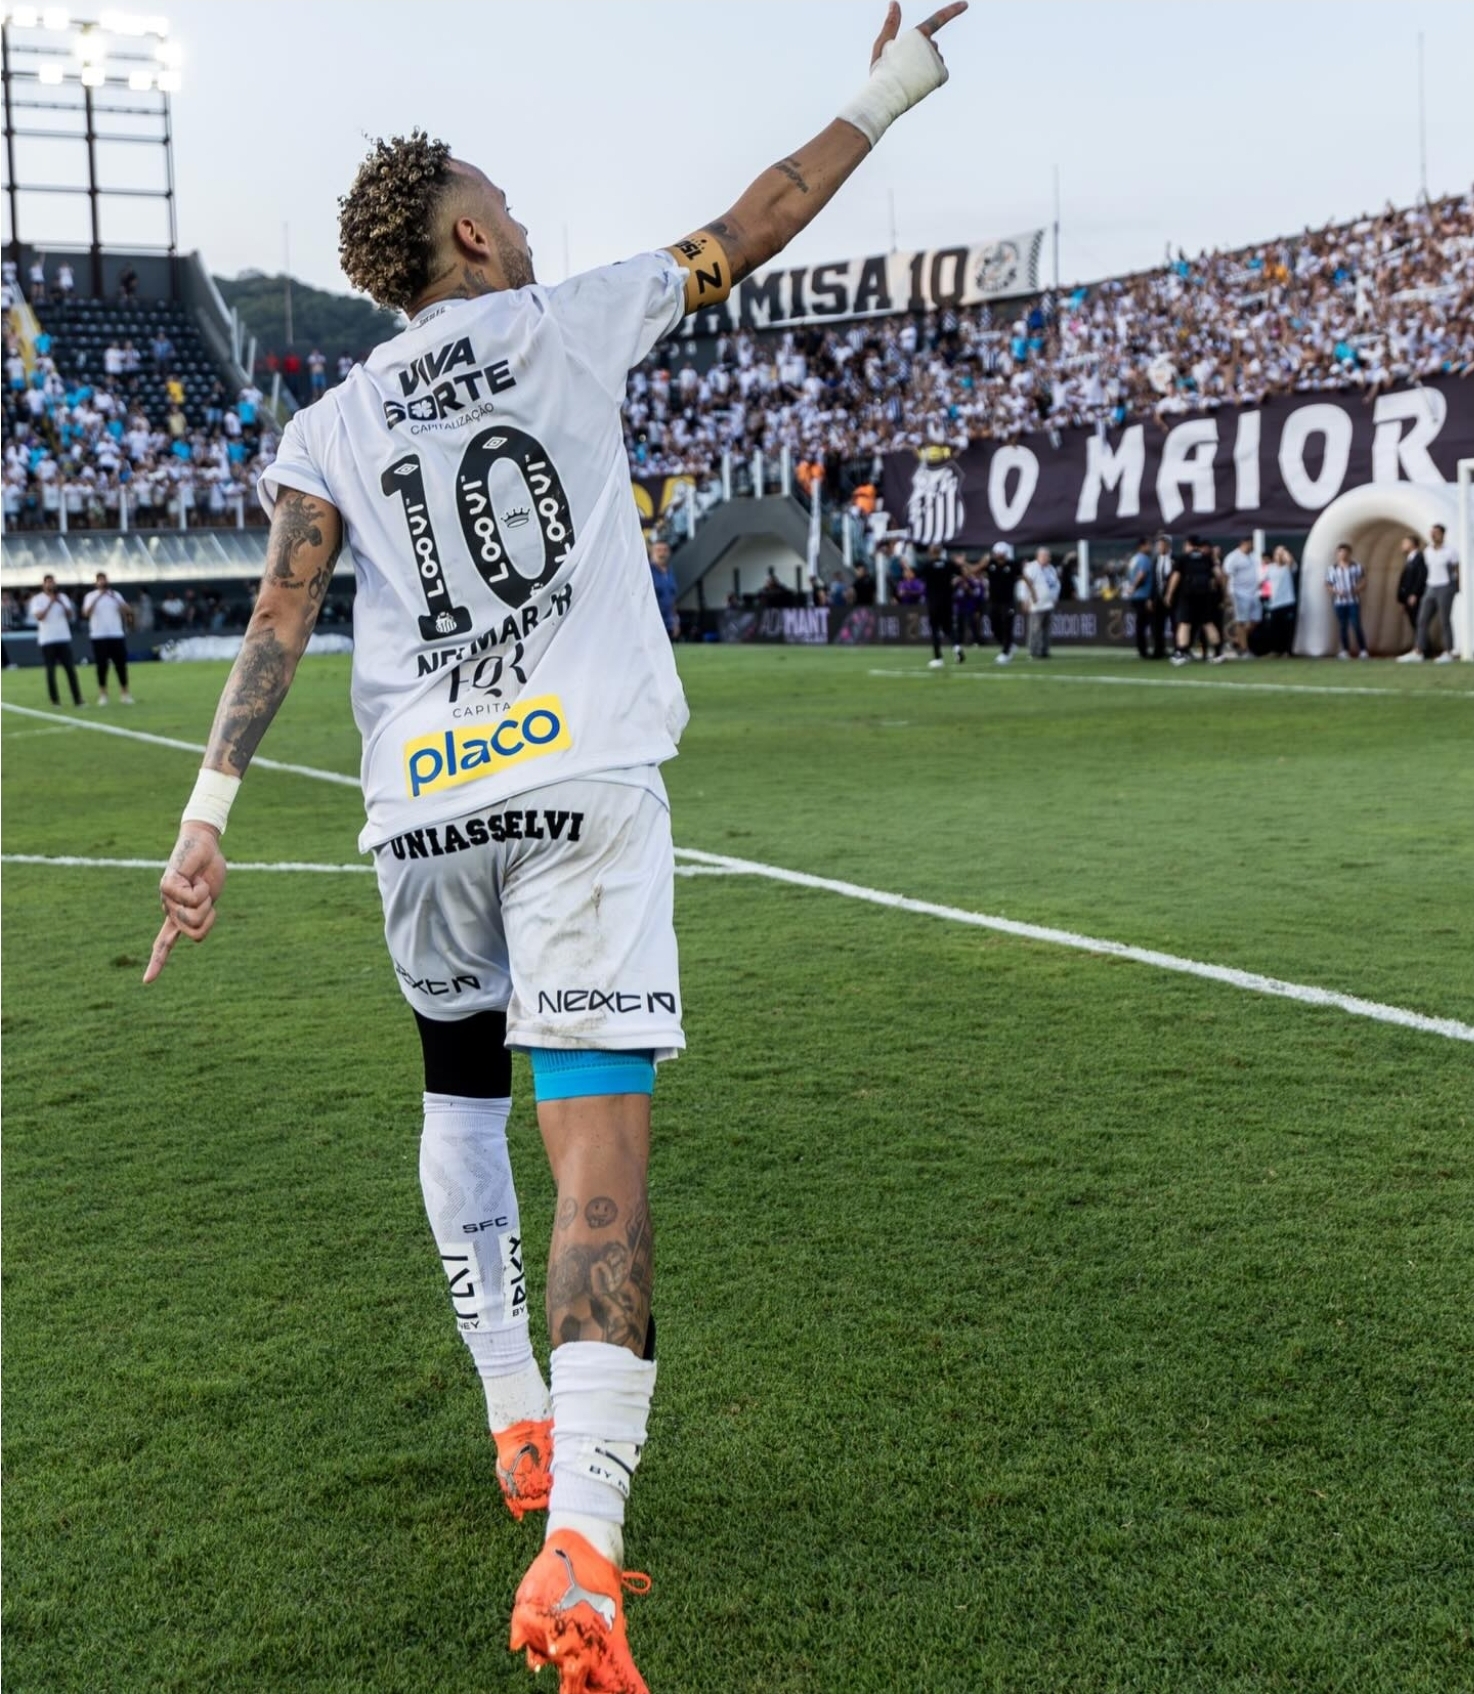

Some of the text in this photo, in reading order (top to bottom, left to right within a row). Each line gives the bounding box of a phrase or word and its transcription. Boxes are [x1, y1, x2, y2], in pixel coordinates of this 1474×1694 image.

[908, 247, 969, 309] 10
[383, 359, 517, 430] SORTE
[398, 336, 476, 397] VIVA
[410, 402, 494, 435] CAPITALIZAÇÃO
[988, 387, 1448, 531] O MAIOR
[380, 425, 576, 641] 10
[406, 503, 445, 598] LOOVI
[462, 480, 509, 583] LOOVI
[452, 702, 511, 719] CAPITA
[409, 709, 560, 796] placo
[390, 810, 584, 860] UNIASSELVI
[463, 1216, 508, 1234] SFC
[459, 1320, 480, 1330] EY
